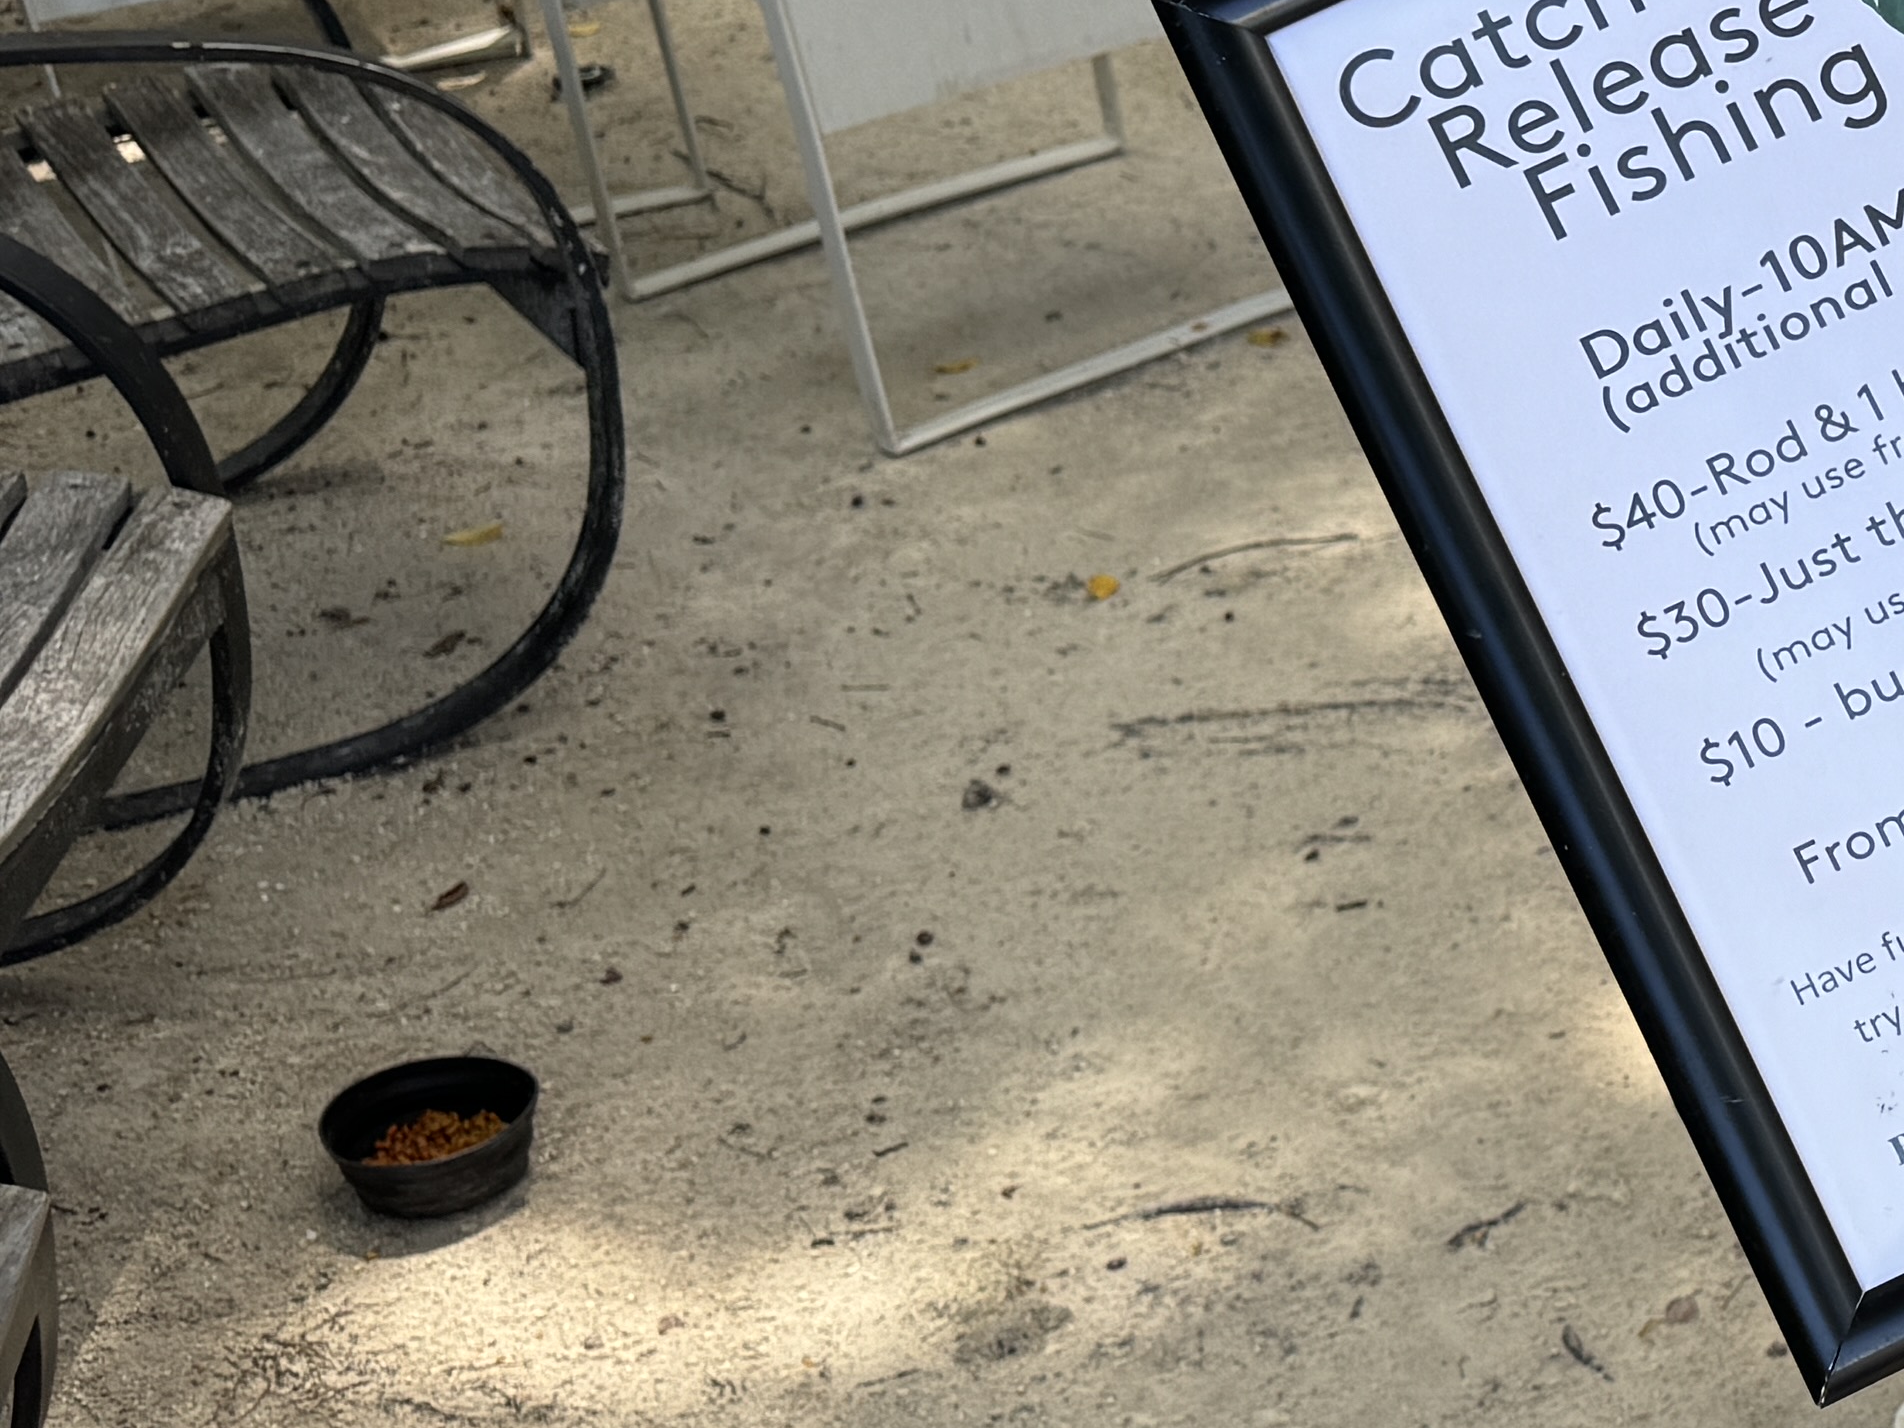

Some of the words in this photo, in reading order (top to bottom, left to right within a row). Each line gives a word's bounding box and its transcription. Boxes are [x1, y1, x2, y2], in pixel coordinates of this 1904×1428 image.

[1523, 44, 1887, 241] Fishing
[1603, 260, 1893, 433] (additional
[1815, 404, 1859, 442] &
[1857, 384, 1884, 421] 1
[1695, 491, 1788, 556] (may
[1802, 459, 1865, 499] use
[1757, 616, 1851, 683] (may
[1700, 718, 1785, 787] $10
[1790, 953, 1876, 1005] Have
[1854, 1006, 1901, 1042] try
